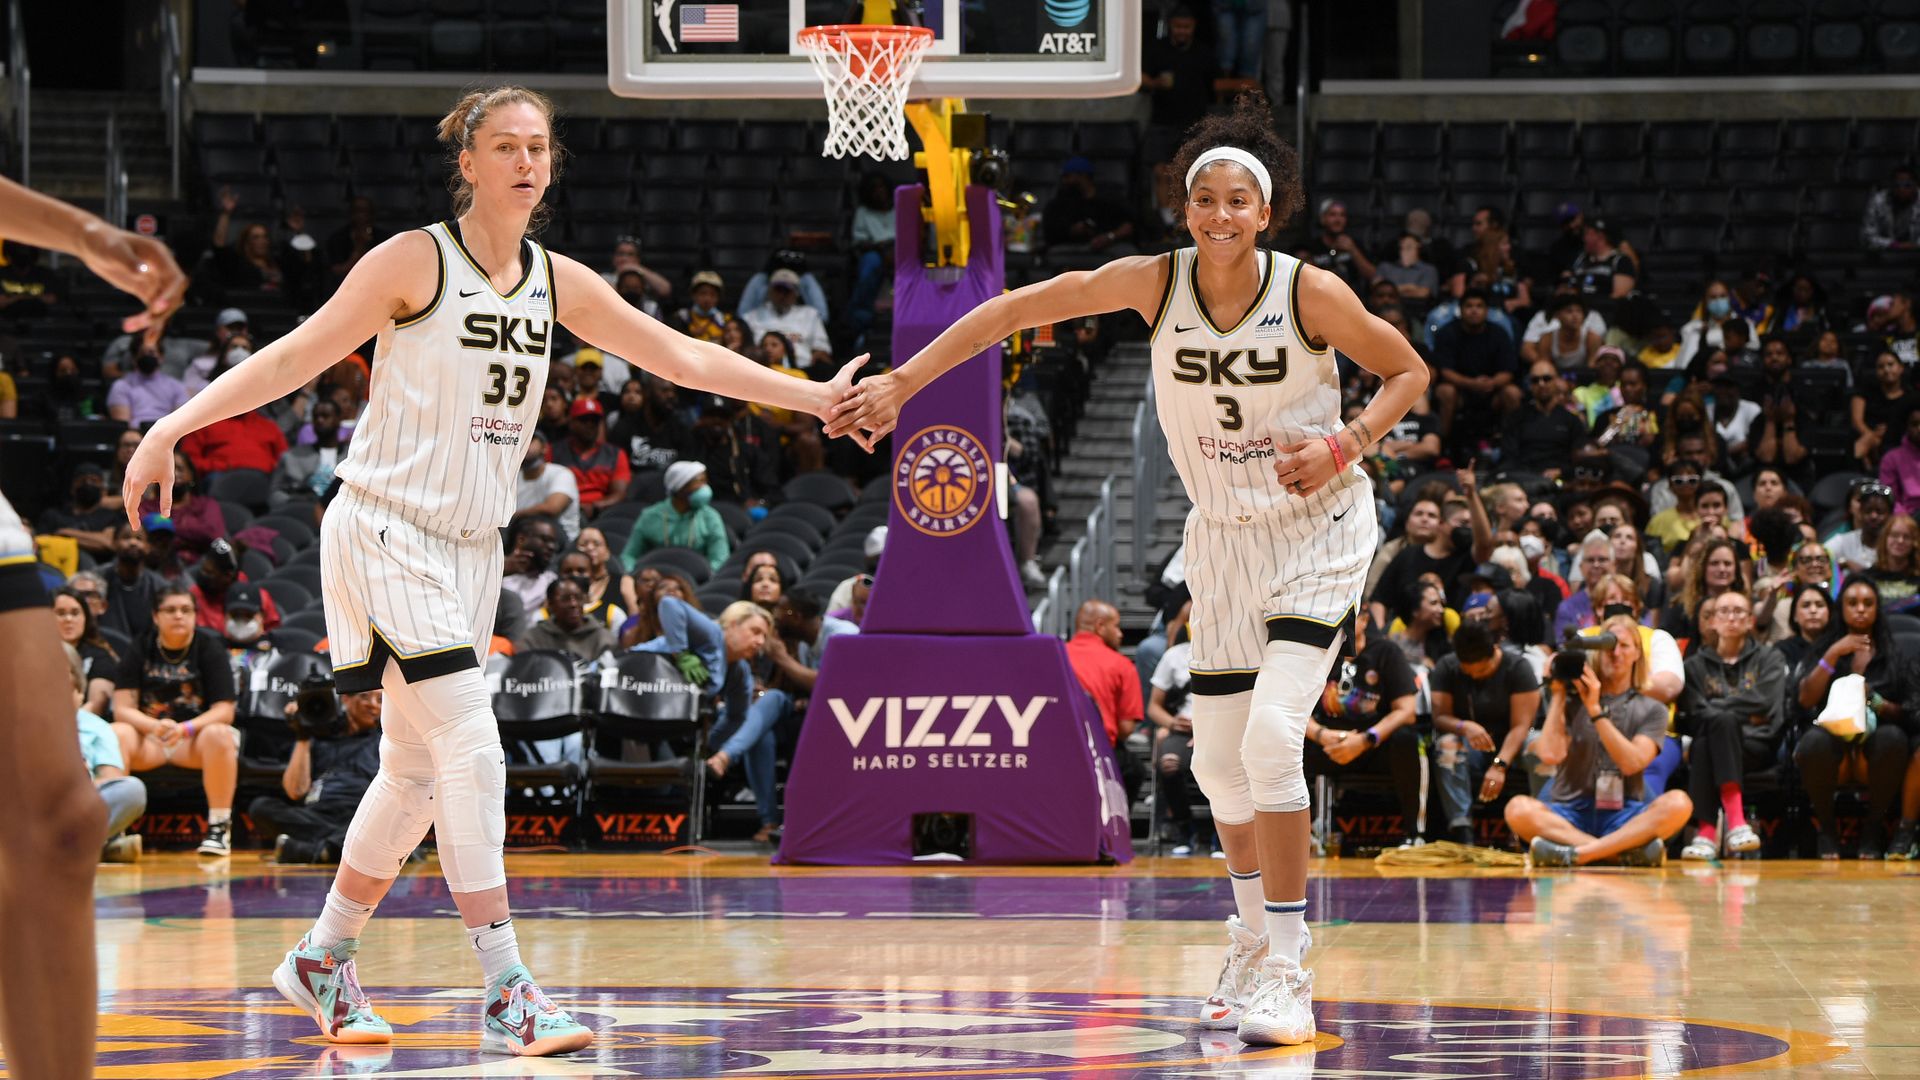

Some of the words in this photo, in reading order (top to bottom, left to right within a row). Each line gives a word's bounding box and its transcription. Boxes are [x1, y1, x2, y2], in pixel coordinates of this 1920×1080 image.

[1039, 33, 1096, 53] AT&T
[457, 312, 549, 357] SKY
[1171, 346, 1288, 387] SKY
[482, 362, 530, 408] 33
[485, 418, 522, 433] UChicago
[1214, 394, 1244, 432] 3
[484, 431, 519, 445] Medicine
[898, 450, 916, 487] LOS
[922, 430, 988, 482] ANGELES
[1220, 448, 1275, 464] Medicine
[908, 504, 978, 530] SPARKS
[827, 696, 1048, 748] VIZZY
[853, 754, 916, 770] HARD
[928, 753, 1028, 768] SELTZER
[595, 814, 685, 834] VIZZY
